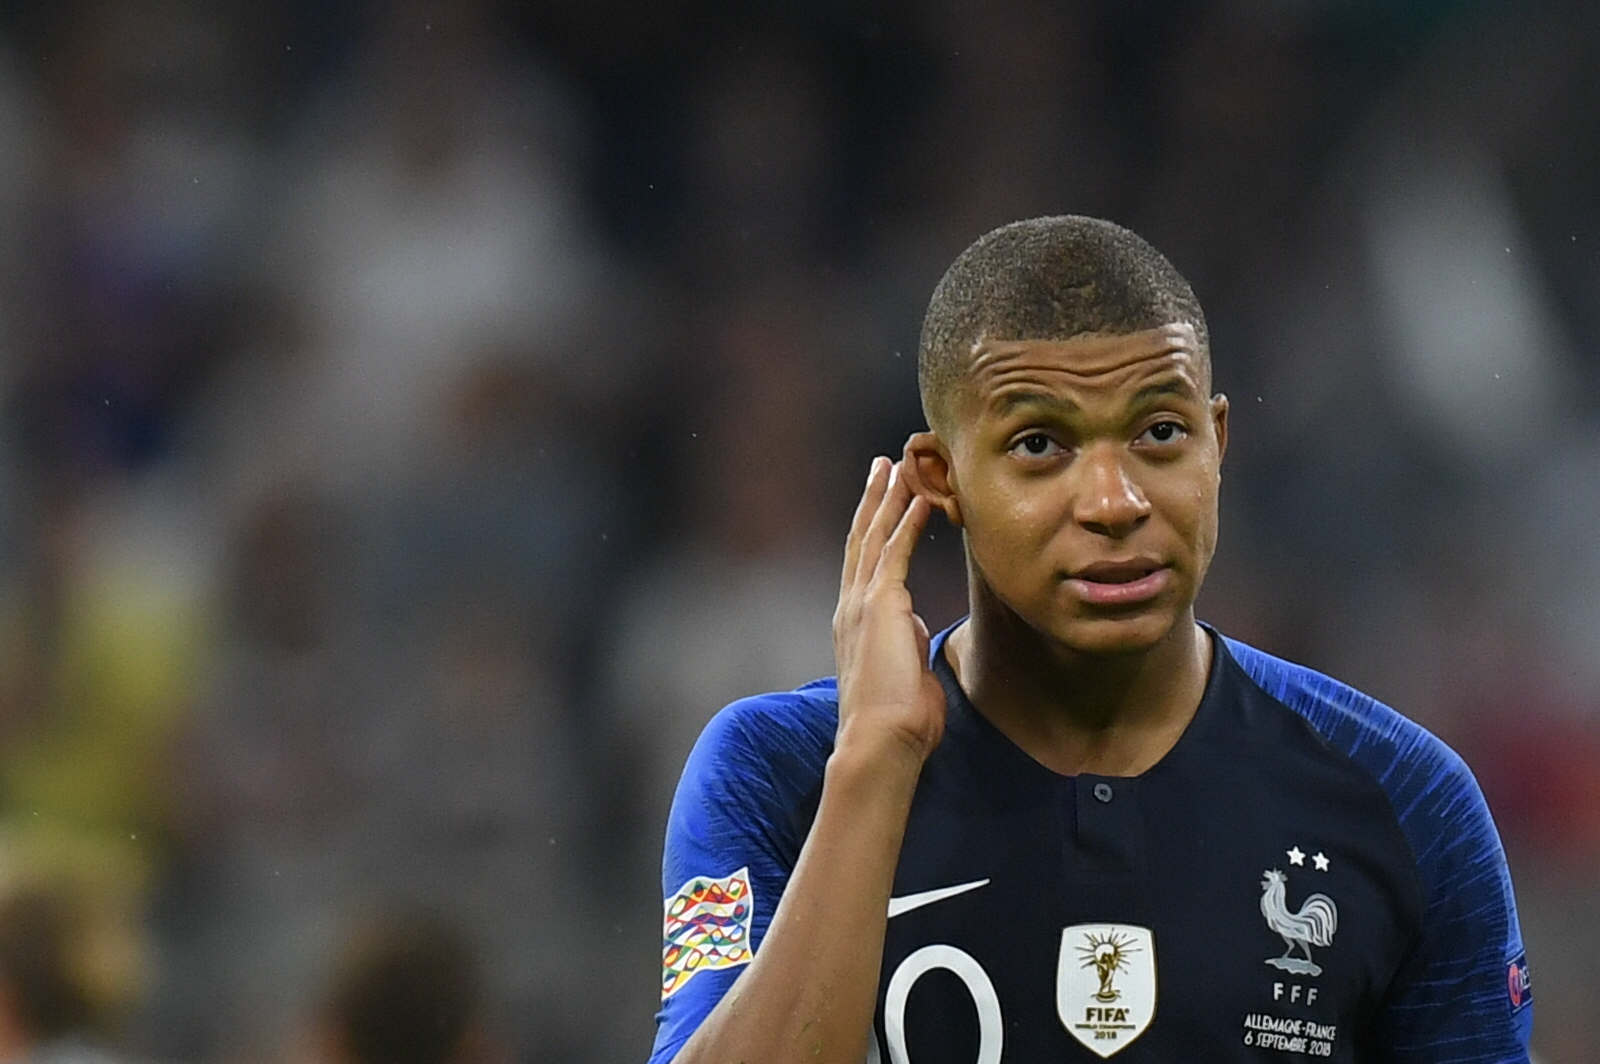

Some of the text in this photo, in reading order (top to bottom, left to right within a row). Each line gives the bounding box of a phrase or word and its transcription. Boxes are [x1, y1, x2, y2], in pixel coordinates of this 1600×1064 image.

[1085, 1007, 1127, 1022] FIFA
[1093, 1031, 1118, 1040] 2018
[1243, 1030, 1332, 1057] 6 SEPTEMBRE 2018
